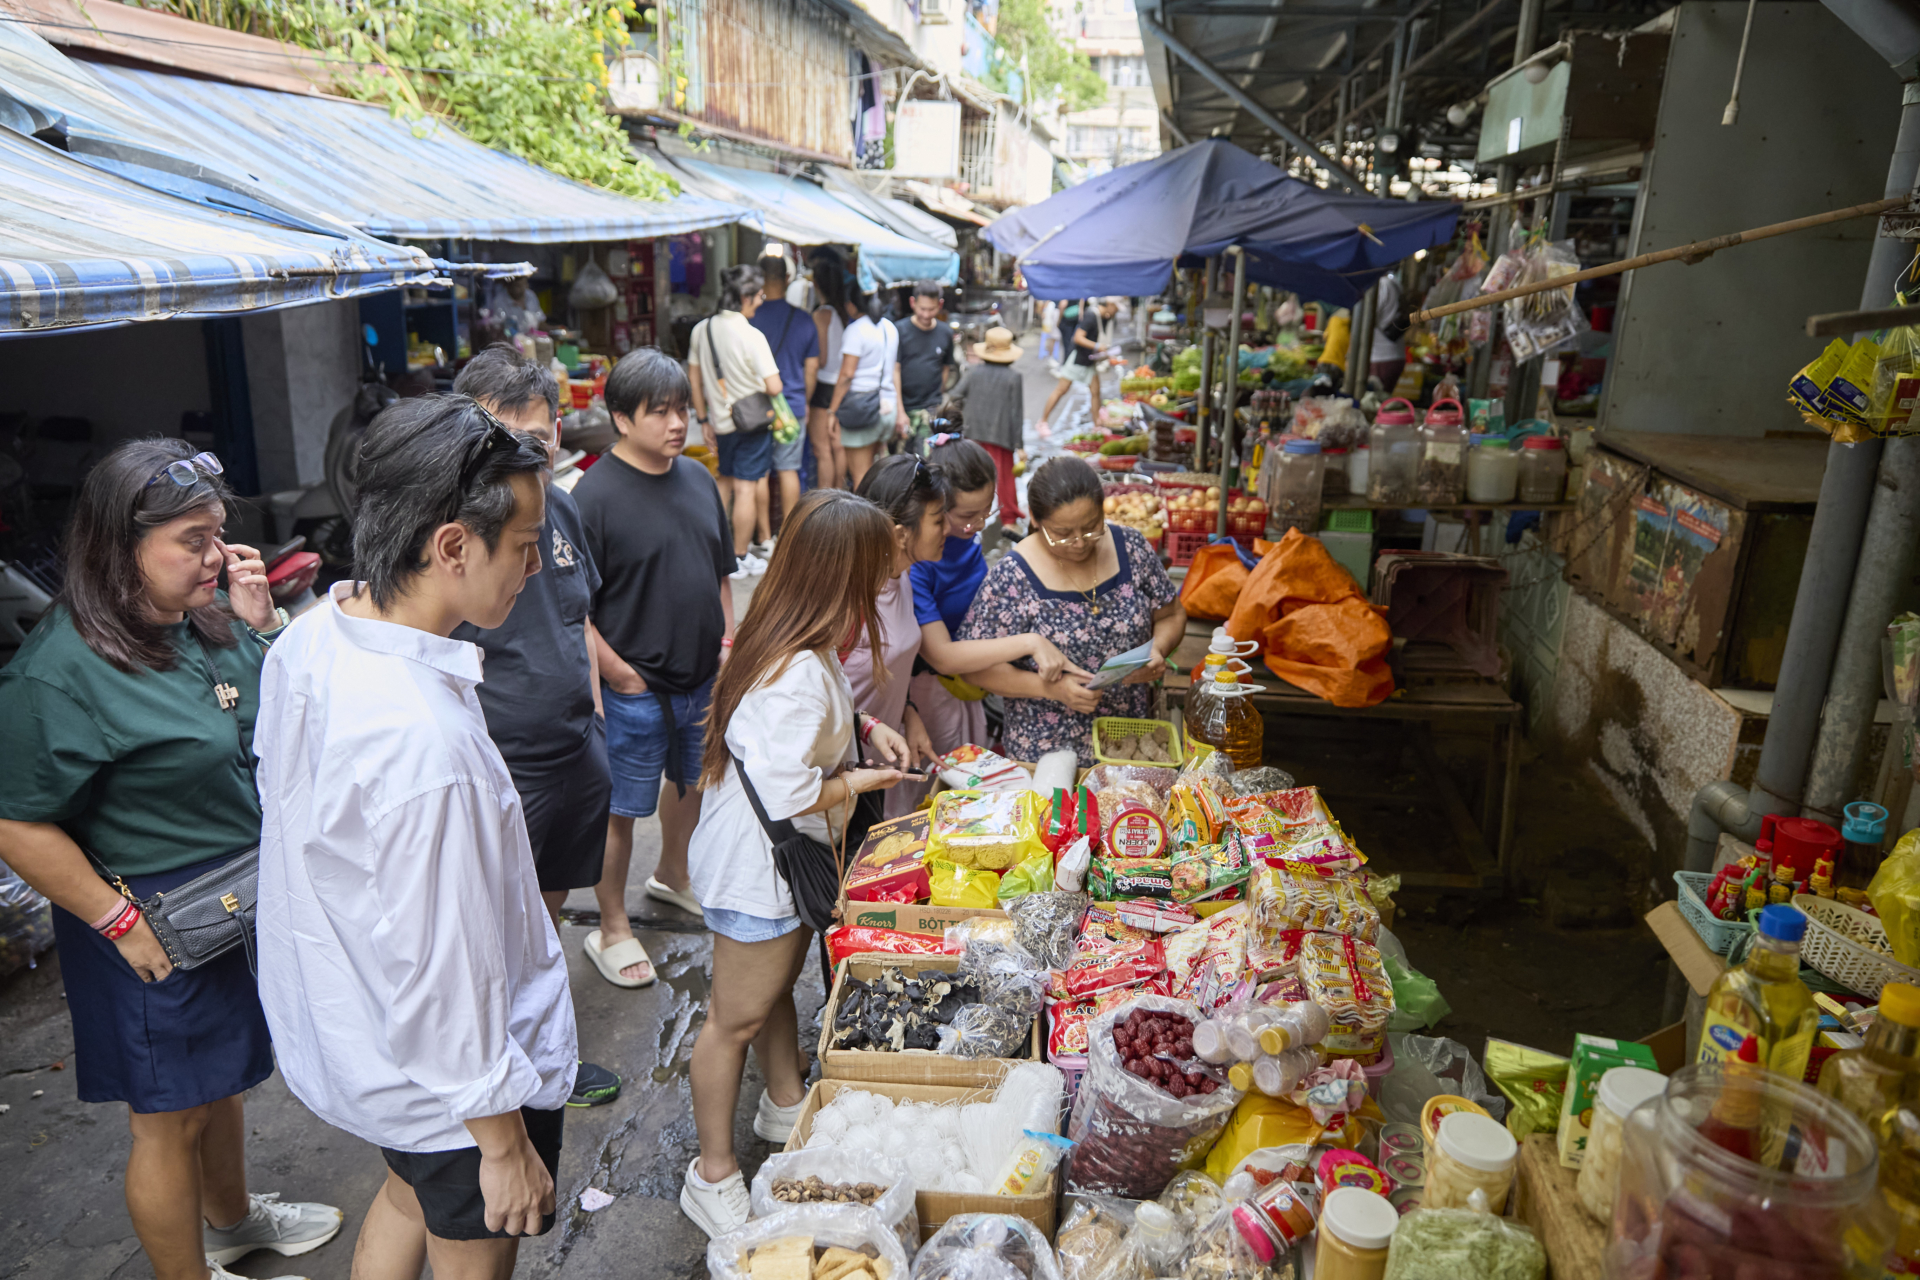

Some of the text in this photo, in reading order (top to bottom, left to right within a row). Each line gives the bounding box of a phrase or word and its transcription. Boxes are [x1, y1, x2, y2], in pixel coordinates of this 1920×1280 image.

[1118, 838, 1157, 847] MODERN
[1283, 859, 1316, 871] WAI
[1285, 864, 1319, 876] WAI
[1122, 876, 1172, 889] Omachi
[858, 916, 895, 929] Knorr
[918, 916, 946, 934] BỘT
[1064, 1002, 1098, 1017] LẨU
[1713, 1026, 1742, 1050] Simp
